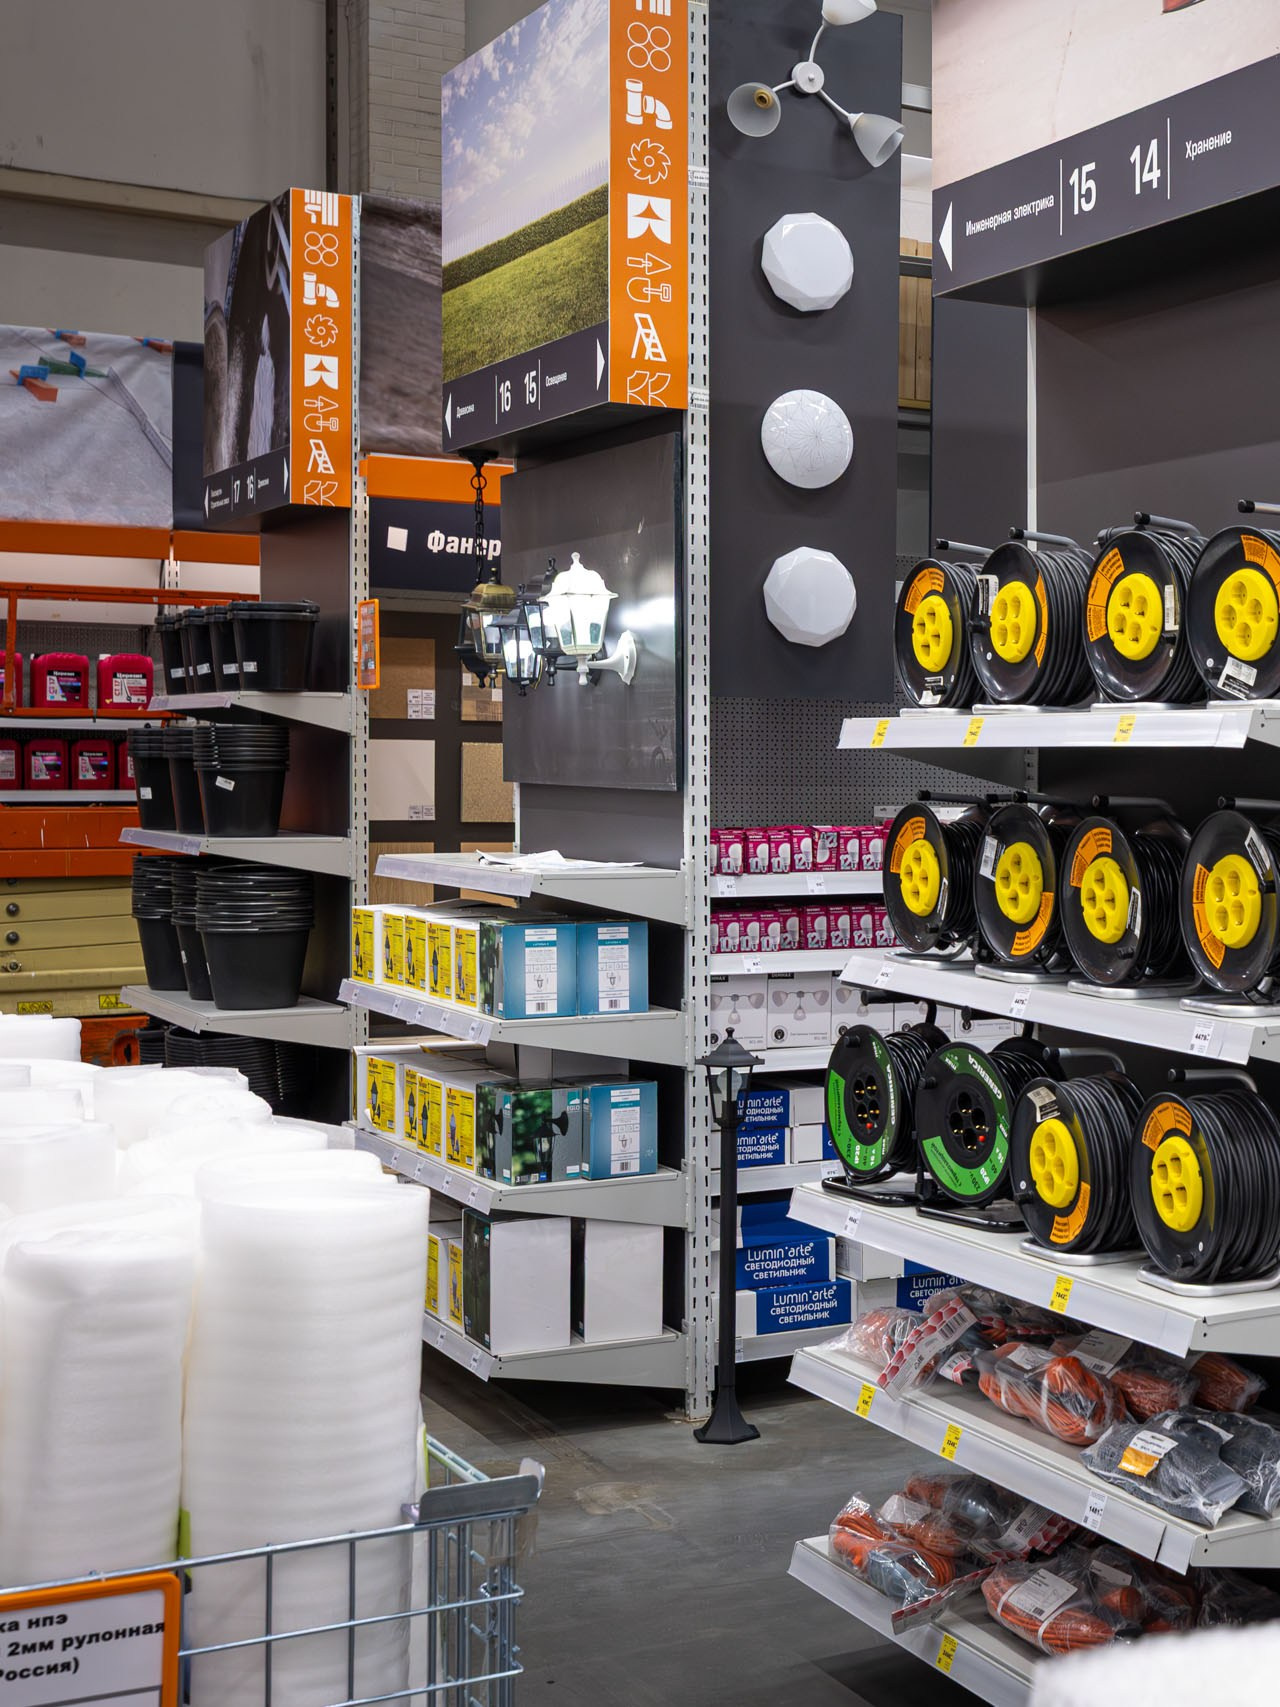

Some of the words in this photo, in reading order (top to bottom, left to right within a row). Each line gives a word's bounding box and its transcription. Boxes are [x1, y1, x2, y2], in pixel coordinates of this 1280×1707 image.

[1185, 129, 1232, 160] Хранение
[1129, 138, 1161, 195] 14
[1068, 161, 1097, 215] 15
[965, 208, 1012, 237] Инженерная
[1013, 194, 1055, 219] электрика
[499, 380, 512, 413] 16
[523, 370, 537, 405] 15
[233, 479, 241, 504] 17
[246, 474, 254, 500] 16
[968, 1053, 1003, 1100] GENERICA
[979, 1167, 990, 1185] IP20
[744, 1256, 815, 1271] СВЕТОДИОДНЫЙ
[752, 1267, 807, 1280] СВЕТИЛЬНИК
[770, 1299, 838, 1316] СВЕТОДИОДНЫЙ
[778, 1311, 830, 1325] СВЕТИЛЬНИК
[27, 1613, 69, 1629] нпэ
[7, 1640, 54, 1657] 2мм
[61, 1621, 166, 1652] рулонная
